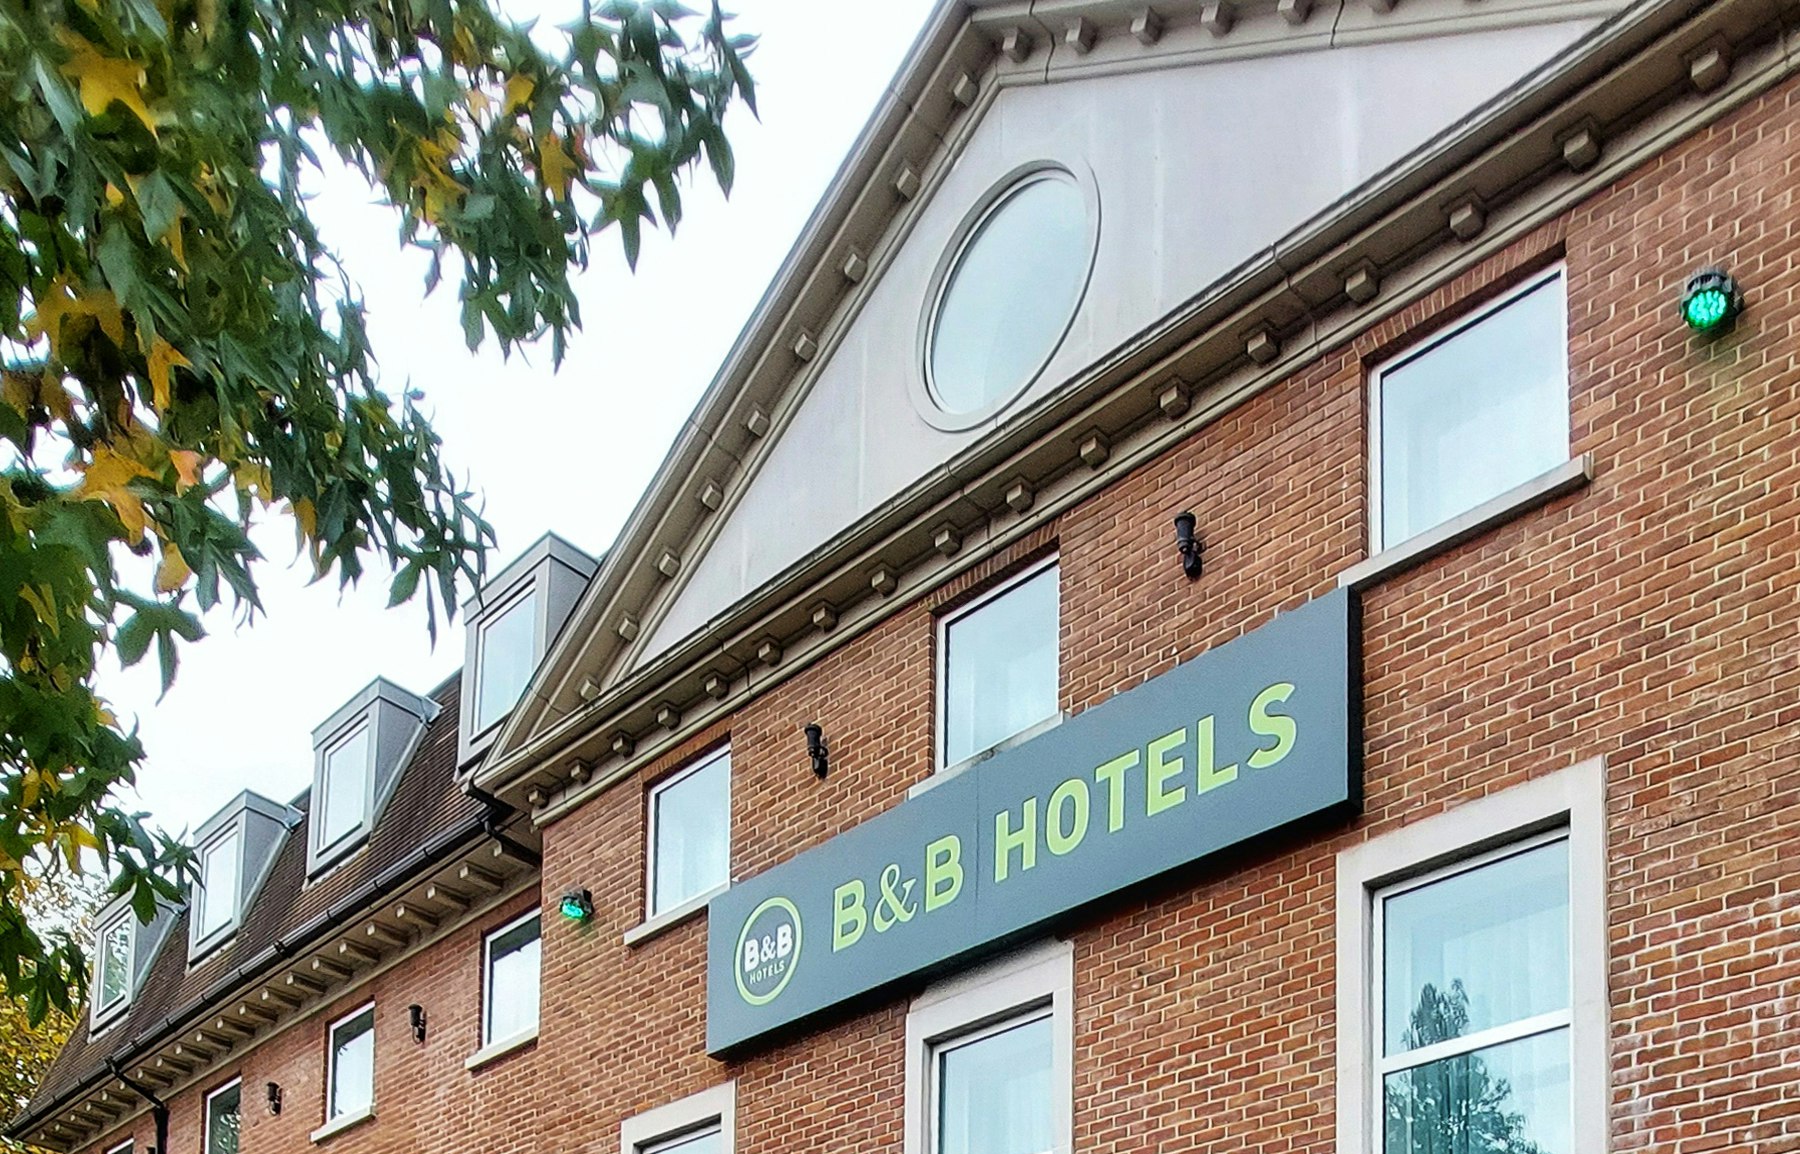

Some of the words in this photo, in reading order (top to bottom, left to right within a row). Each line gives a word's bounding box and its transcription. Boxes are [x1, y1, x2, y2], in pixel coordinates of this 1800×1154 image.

[832, 834, 965, 954] B&B
[994, 682, 1298, 884] HOTELS
[744, 923, 793, 973] B&B
[749, 959, 785, 985] HOTELS
